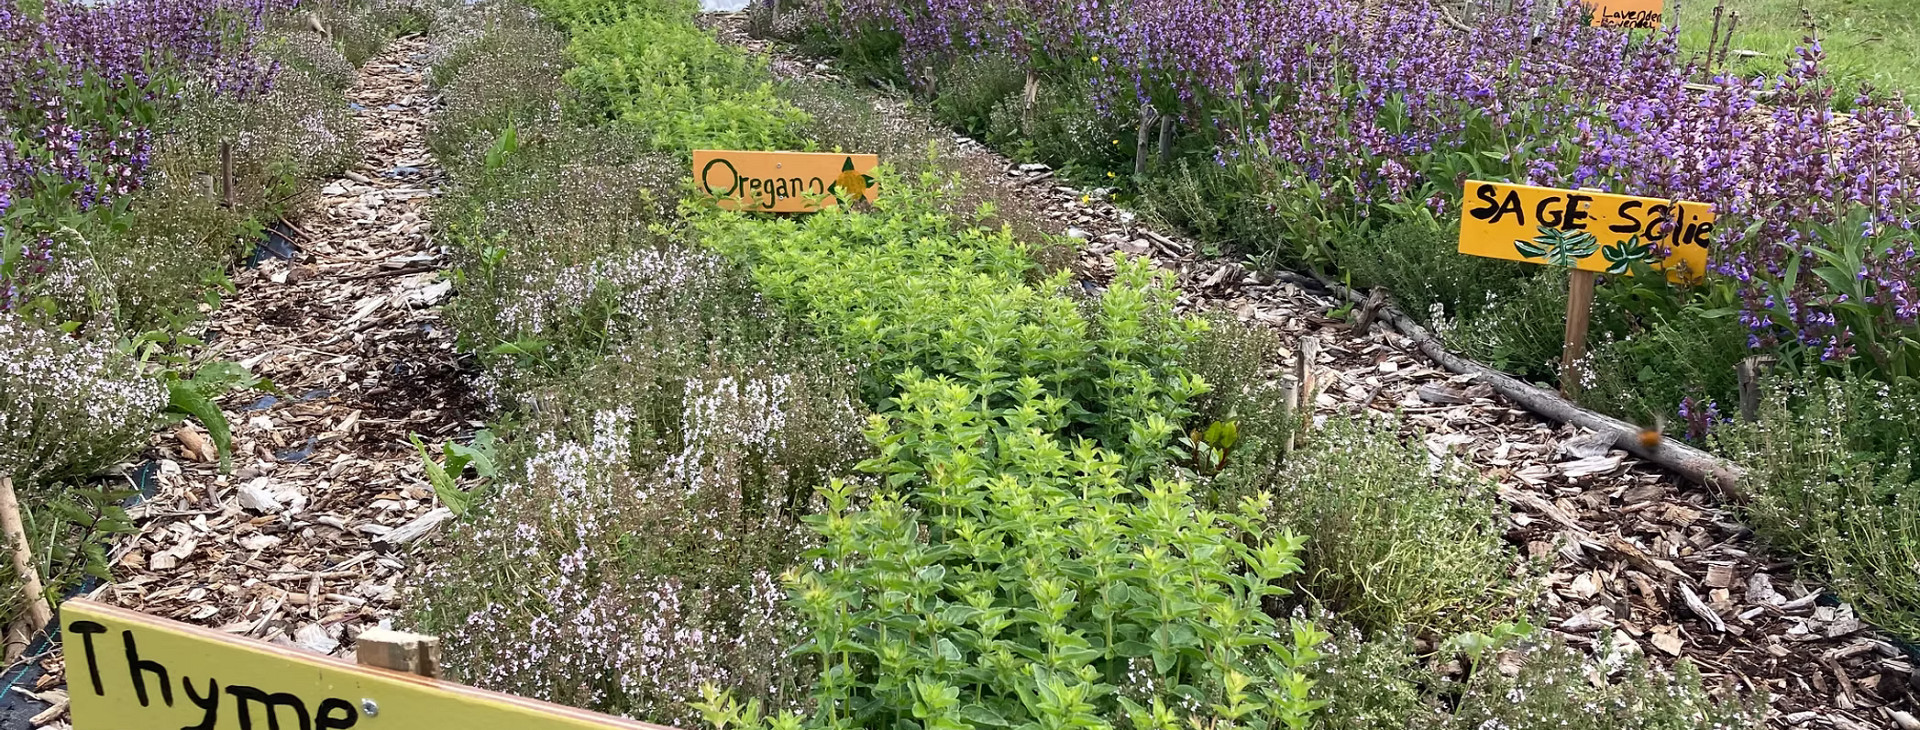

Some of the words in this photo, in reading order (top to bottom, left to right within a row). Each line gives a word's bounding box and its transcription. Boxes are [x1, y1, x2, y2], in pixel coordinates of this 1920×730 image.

[702, 158, 824, 209] Oregano
[1609, 200, 1713, 248] Salie
[69, 620, 358, 730] Thyme
